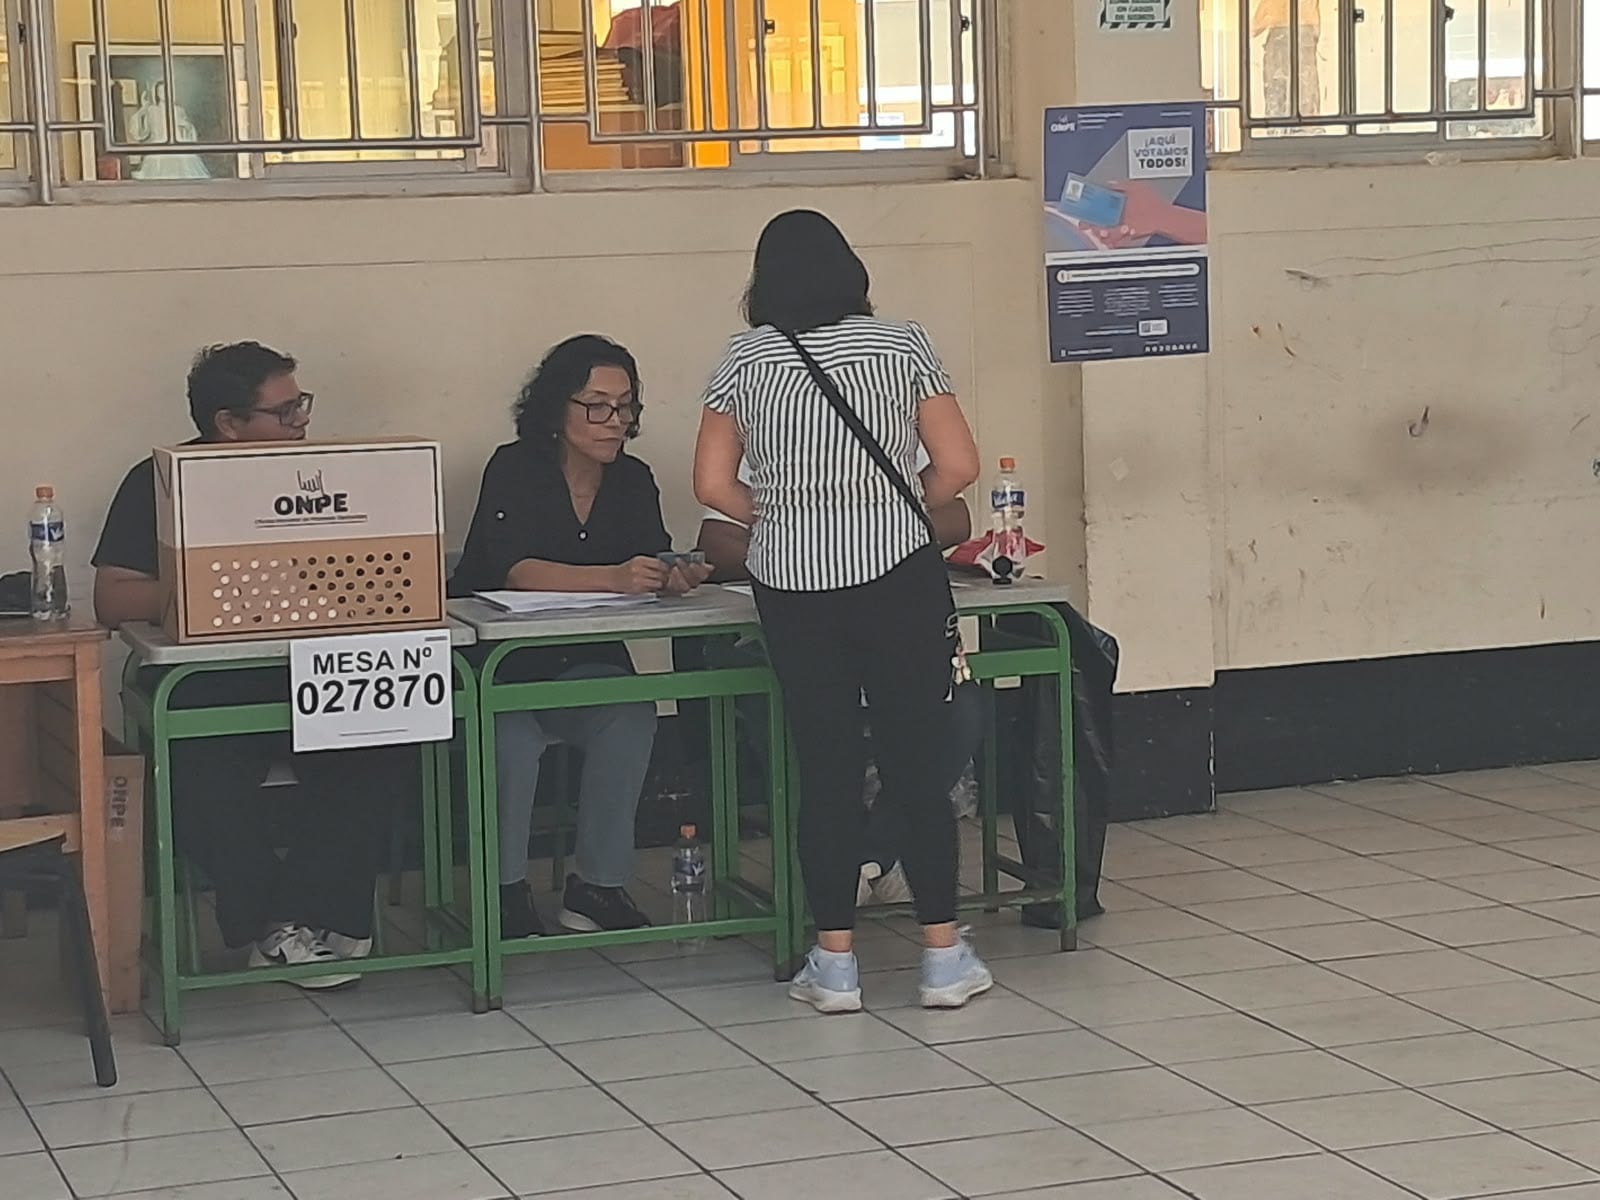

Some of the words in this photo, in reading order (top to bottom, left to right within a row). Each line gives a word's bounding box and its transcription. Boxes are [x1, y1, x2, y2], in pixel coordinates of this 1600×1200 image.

[1134, 147, 1189, 157] VOTAMOS
[1139, 157, 1186, 169] TODOS!
[274, 493, 348, 515] ONPE
[313, 650, 395, 675] MESA
[403, 646, 432, 669] Nº
[297, 673, 445, 715] 027870
[112, 776, 127, 828] ONPE
